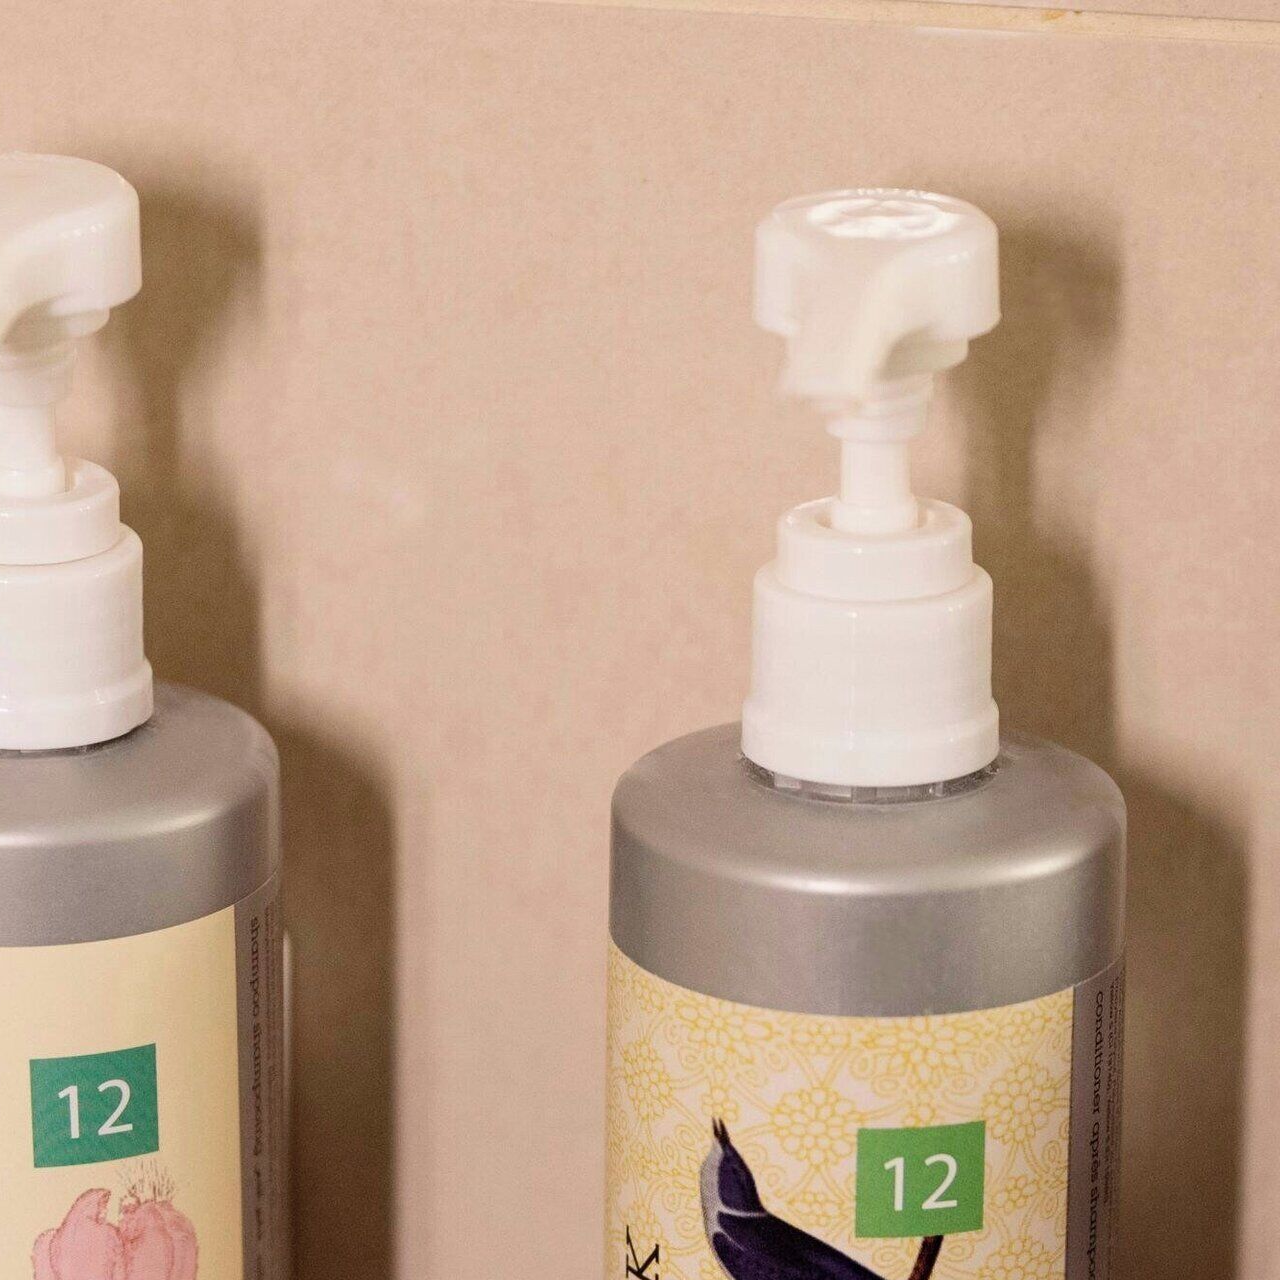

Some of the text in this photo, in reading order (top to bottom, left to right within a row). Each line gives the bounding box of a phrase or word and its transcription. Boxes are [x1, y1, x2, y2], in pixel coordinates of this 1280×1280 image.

[1092, 990, 1104, 1113] conditioner
[58, 1078, 133, 1139] 12
[883, 1153, 958, 1211] 12
